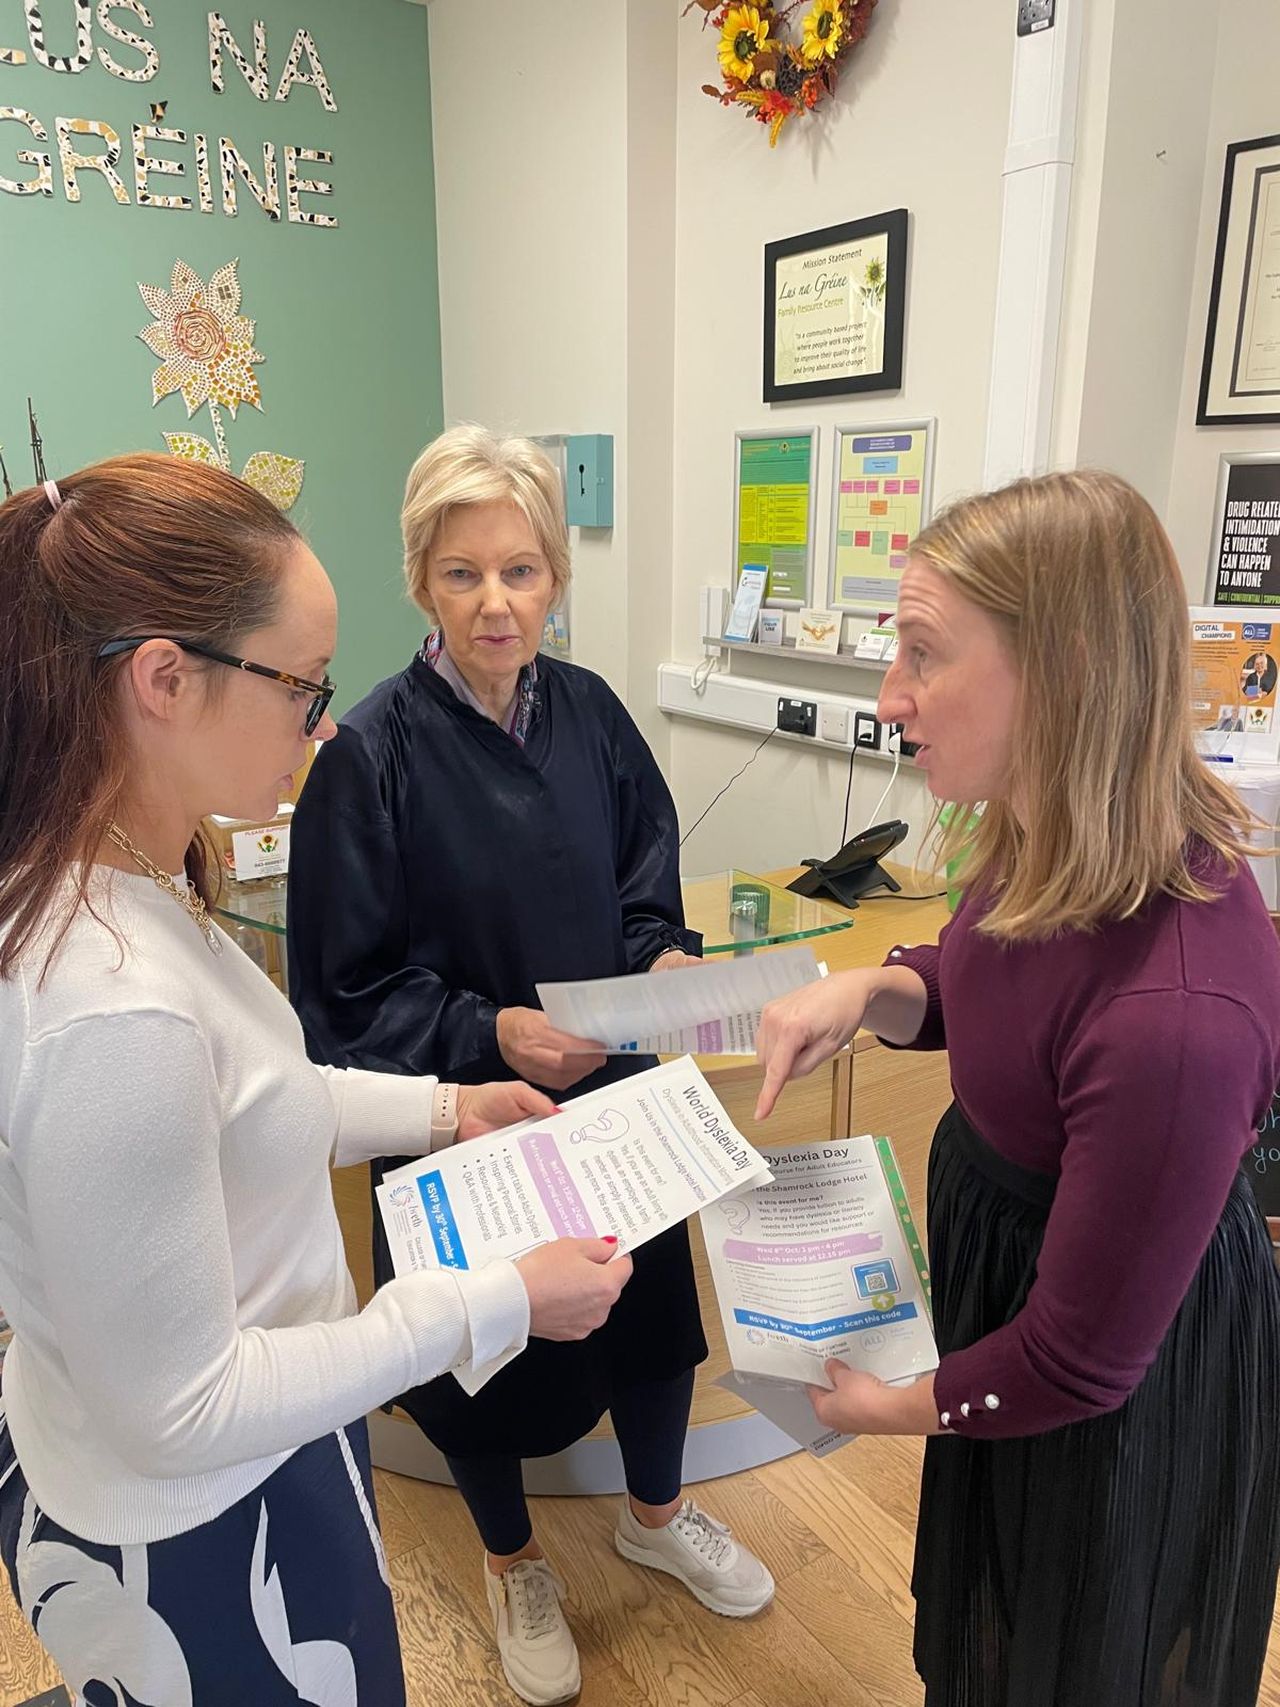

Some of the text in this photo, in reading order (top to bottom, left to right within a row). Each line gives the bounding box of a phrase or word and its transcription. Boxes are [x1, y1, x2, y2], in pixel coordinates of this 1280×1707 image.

[0, 0, 338, 112] US NA
[0, 100, 339, 228] GRÉINE
[802, 249, 862, 270] Mission Statement
[778, 272, 847, 301] Lus na Gréine
[778, 298, 844, 318] Family Resource Centre
[1227, 501, 1250, 518] DRUG
[1225, 519, 1280, 536] INTIMIDATION
[1223, 537, 1268, 553] & VIOLENCE
[1221, 554, 1271, 570] CAN HAPPEN
[1220, 571, 1262, 588] TO ANYONE
[636, 1098, 648, 1112] Join
[644, 1111, 653, 1121] Us
[658, 1135, 678, 1160] Shamrock
[673, 1158, 687, 1175] Lodge
[682, 1085, 714, 1119] World
[703, 1117, 738, 1155] Dyslexia
[731, 1150, 751, 1171] Day
[762, 1148, 849, 1166] Dyslexia Day
[827, 1159, 862, 1169] Educators
[426, 1182, 439, 1203] RSVP
[772, 1182, 814, 1192] Shamrock
[816, 1179, 842, 1188] Lodge
[844, 1173, 867, 1184] Hotel
[462, 1171, 492, 1241] Q&A with Professionals
[476, 1165, 494, 1202] Resources
[489, 1205, 507, 1238] Networking
[488, 1159, 522, 1234] Inspiring Personal Stories
[503, 1154, 517, 1179] Expert
[511, 1178, 523, 1193] talks
[525, 1214, 542, 1238] Dyslexia
[431, 1202, 441, 1213] by
[806, 1211, 832, 1219] dyslexia
[438, 1226, 453, 1259] September
[795, 1326, 836, 1337] September
[844, 1320, 864, 1328] Scan
[865, 1314, 880, 1323] this
[881, 1311, 901, 1320] code
